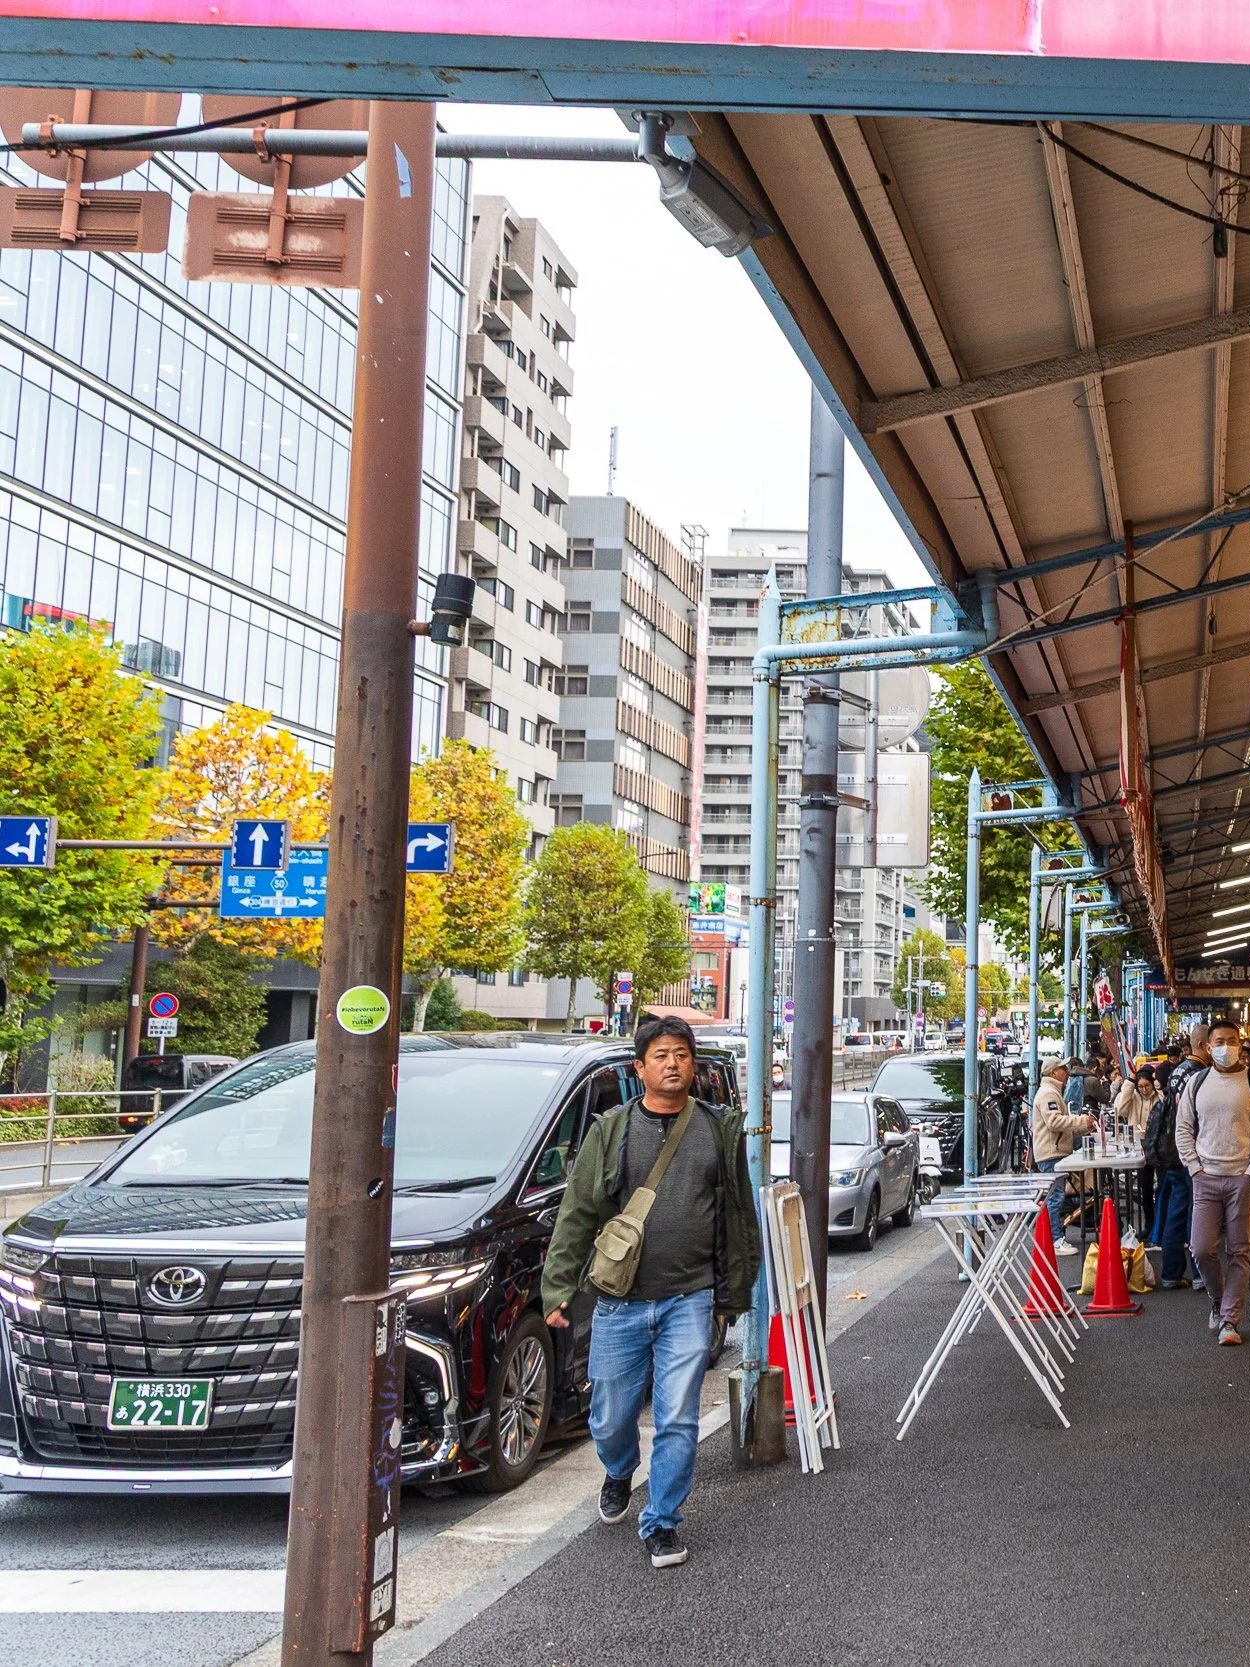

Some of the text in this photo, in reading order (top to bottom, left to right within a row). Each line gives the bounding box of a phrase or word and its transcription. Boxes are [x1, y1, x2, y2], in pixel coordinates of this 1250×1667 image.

[227, 875, 256, 888] 銀座
[274, 879, 286, 889] 50
[130, 1399, 206, 1426] 22-17
